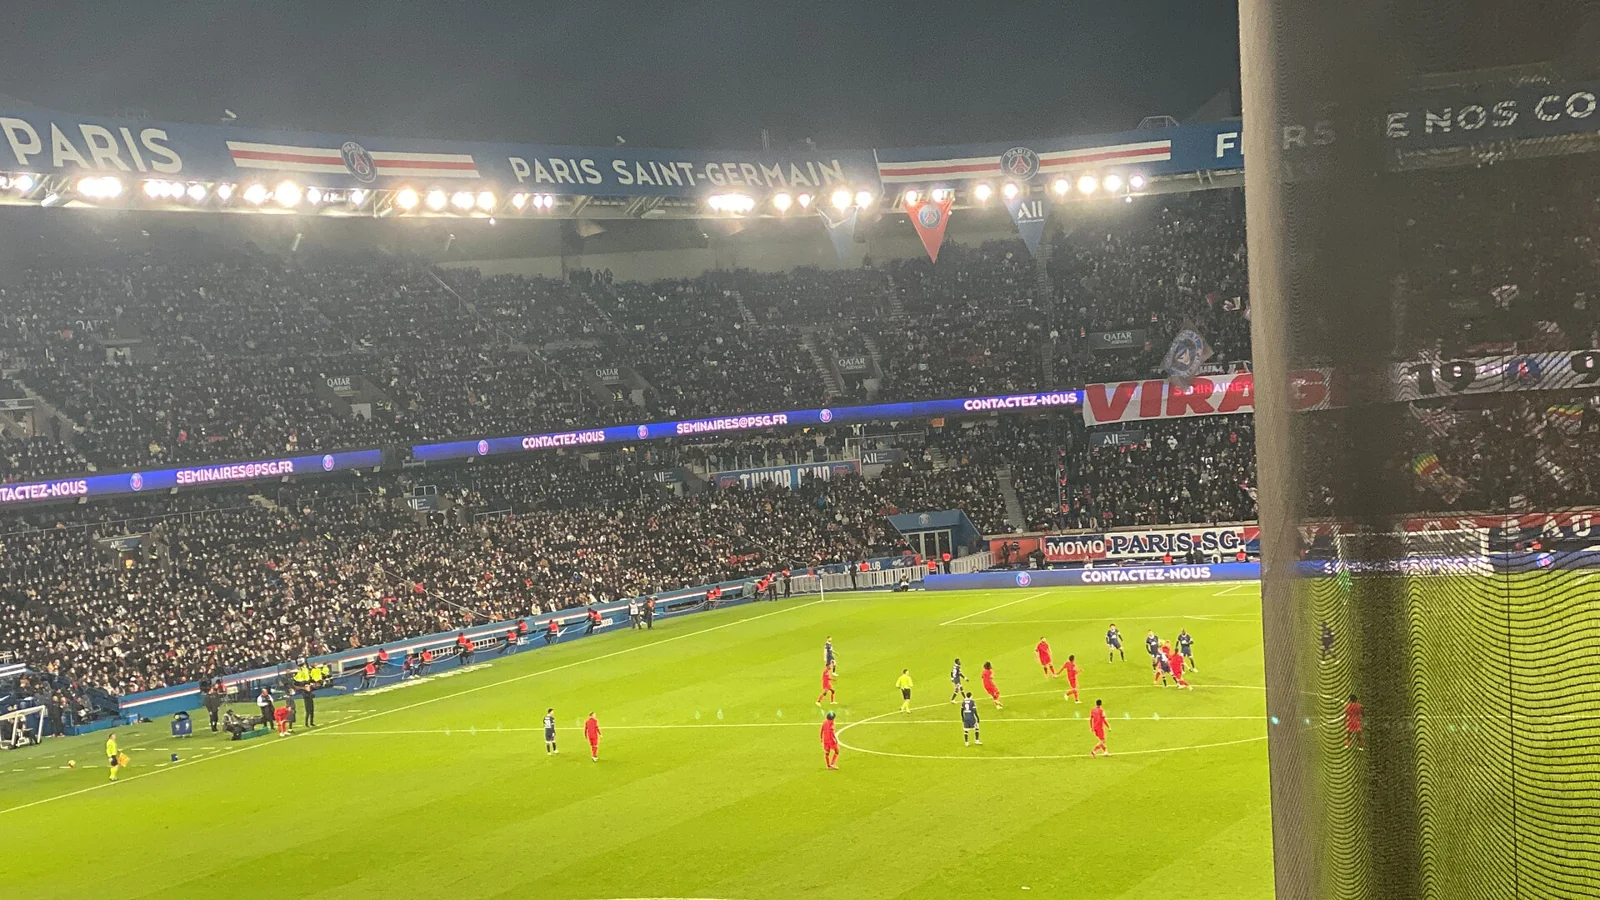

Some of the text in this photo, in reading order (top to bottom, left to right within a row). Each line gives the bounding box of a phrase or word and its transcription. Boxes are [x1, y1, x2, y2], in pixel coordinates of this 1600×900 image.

[1425, 100, 1519, 133] NOS
[0, 117, 183, 173] PARIS
[508, 157, 846, 187] PARIS SAINT-GERMAIN
[1103, 331, 1132, 342] QATAR
[595, 368, 619, 377] QATAR
[838, 357, 865, 367] QATAR
[326, 377, 351, 388] QATAR
[522, 391, 1078, 449] CONTACTEZ-NOUS SEMINAIRES@PSG.FR CONTACTEZ-NOUS
[176, 460, 293, 484] SEMINAIRES@PSG.FR
[1046, 530, 1240, 556] MOMO PARIS SG
[1081, 566, 1211, 583] CONTACTEZ-NOUS
